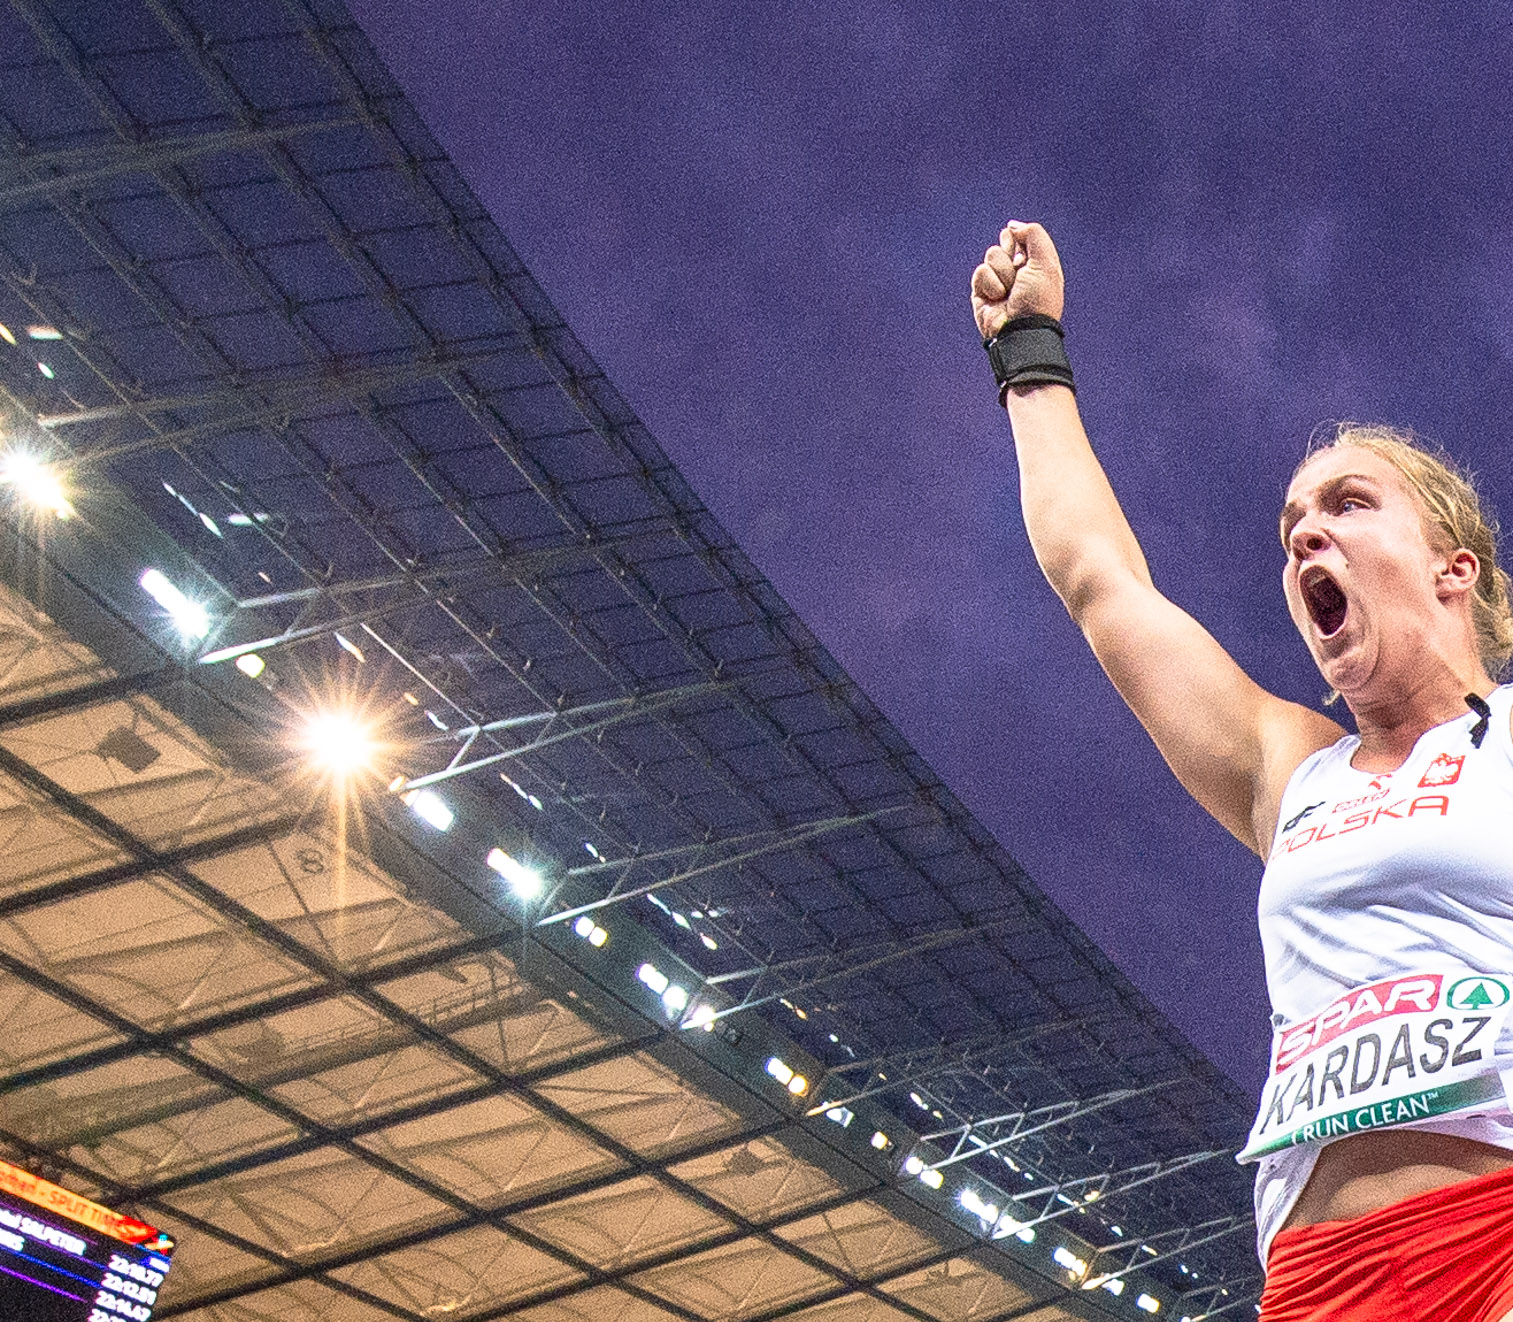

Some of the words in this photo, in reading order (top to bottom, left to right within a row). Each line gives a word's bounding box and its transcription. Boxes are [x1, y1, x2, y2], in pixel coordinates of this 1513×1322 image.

[1277, 979, 1435, 1067] SPAR
[1259, 1016, 1492, 1135] KARDASZ
[1302, 1115, 1350, 1142] RUN
